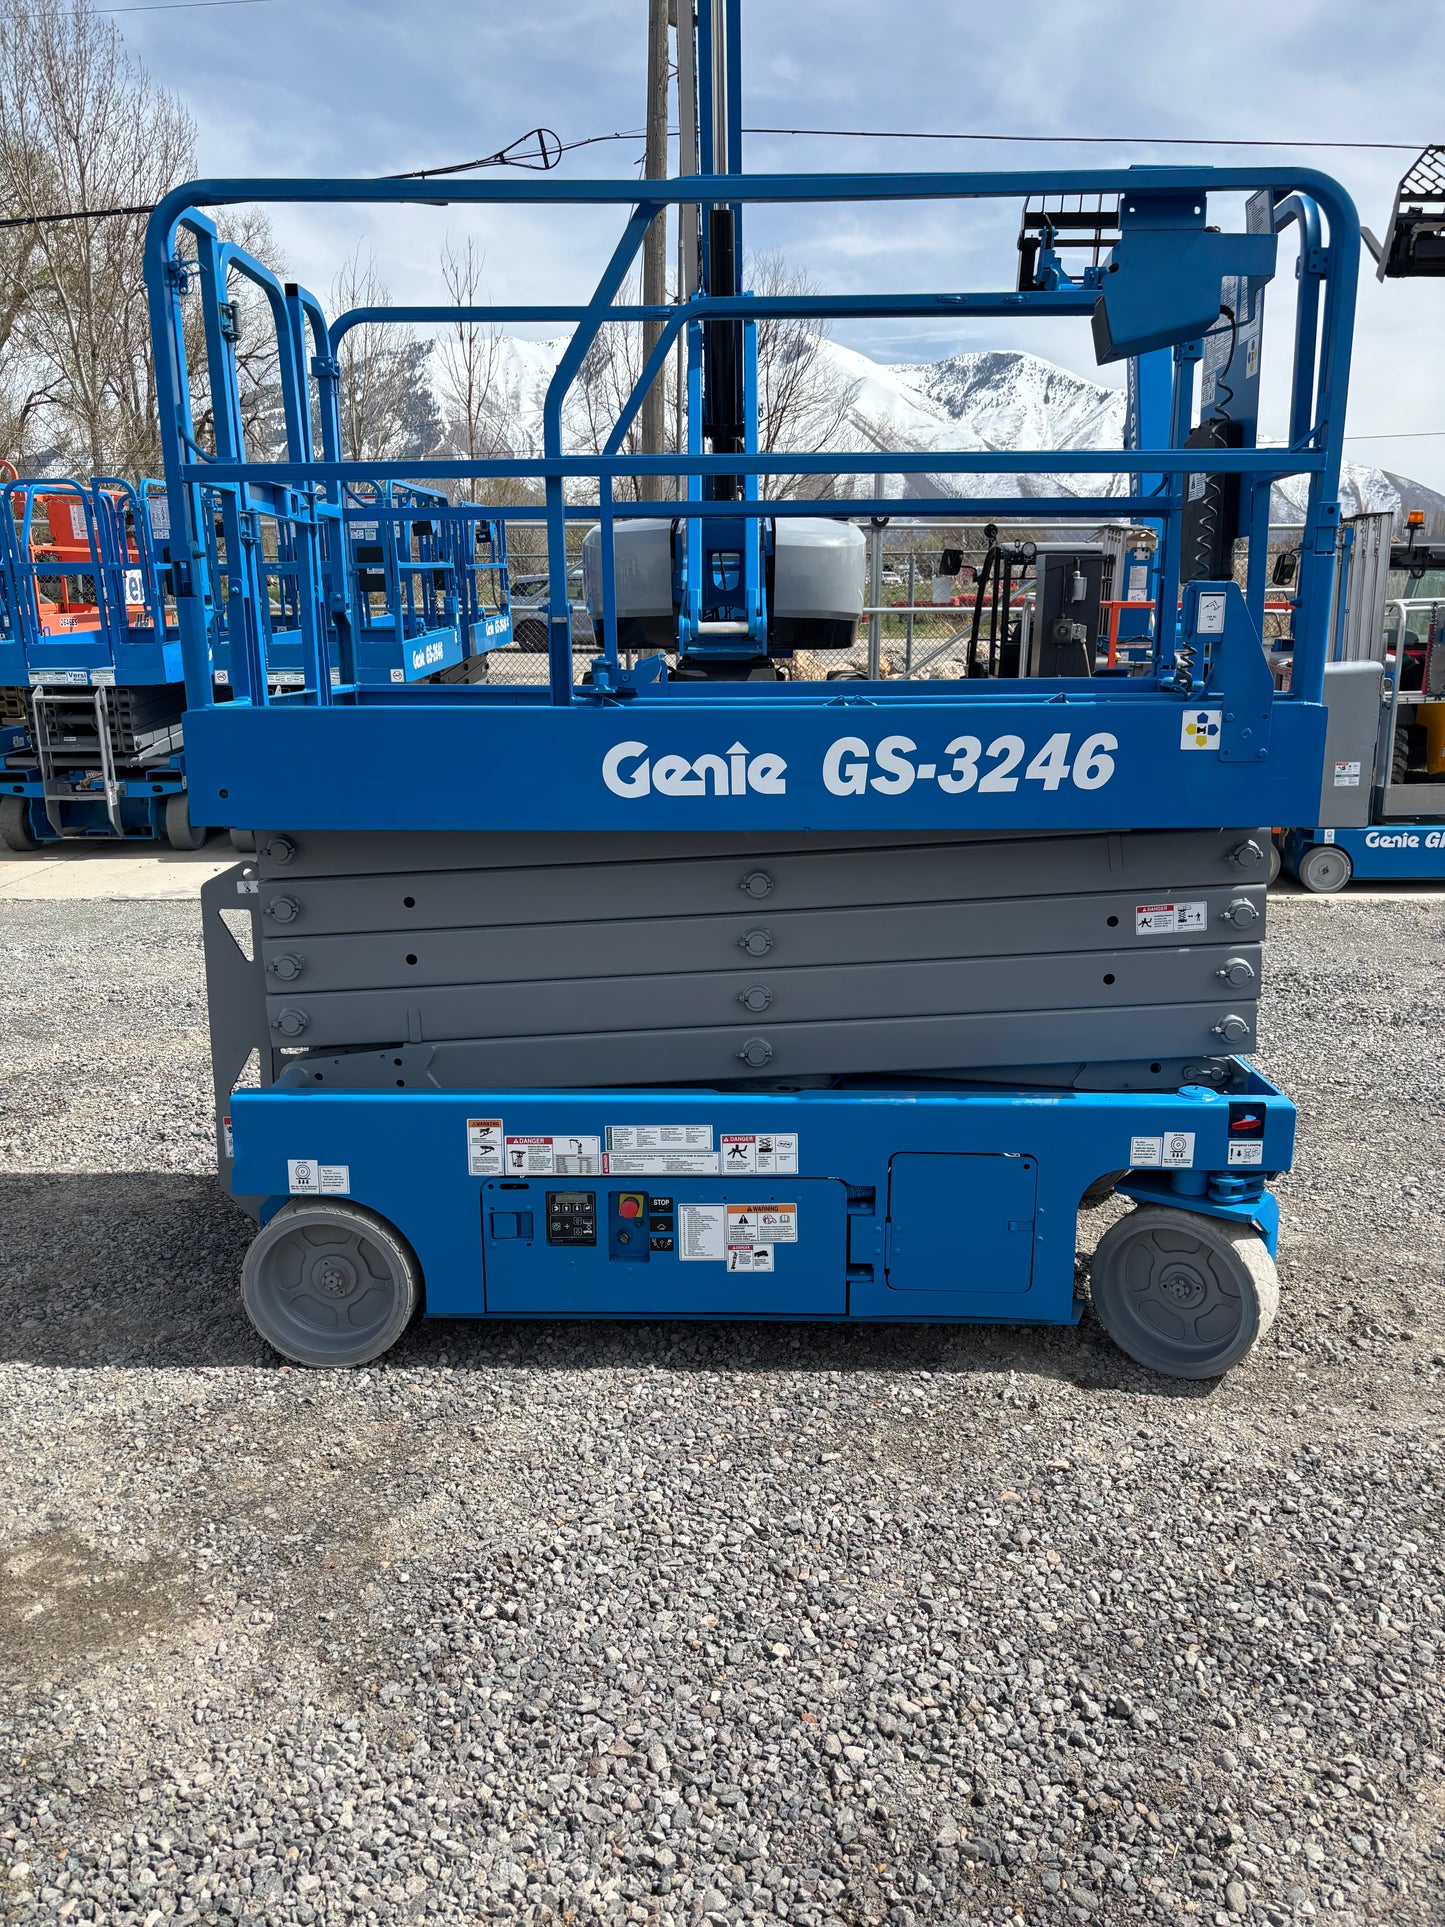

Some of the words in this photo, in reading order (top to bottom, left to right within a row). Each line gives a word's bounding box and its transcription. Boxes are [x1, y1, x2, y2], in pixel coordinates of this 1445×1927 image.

[413, 648, 425, 670] Genie
[426, 641, 443, 664] GS-2646
[602, 741, 788, 799] Genie
[822, 733, 1118, 796] GS-3246
[1365, 832, 1420, 848] Genie
